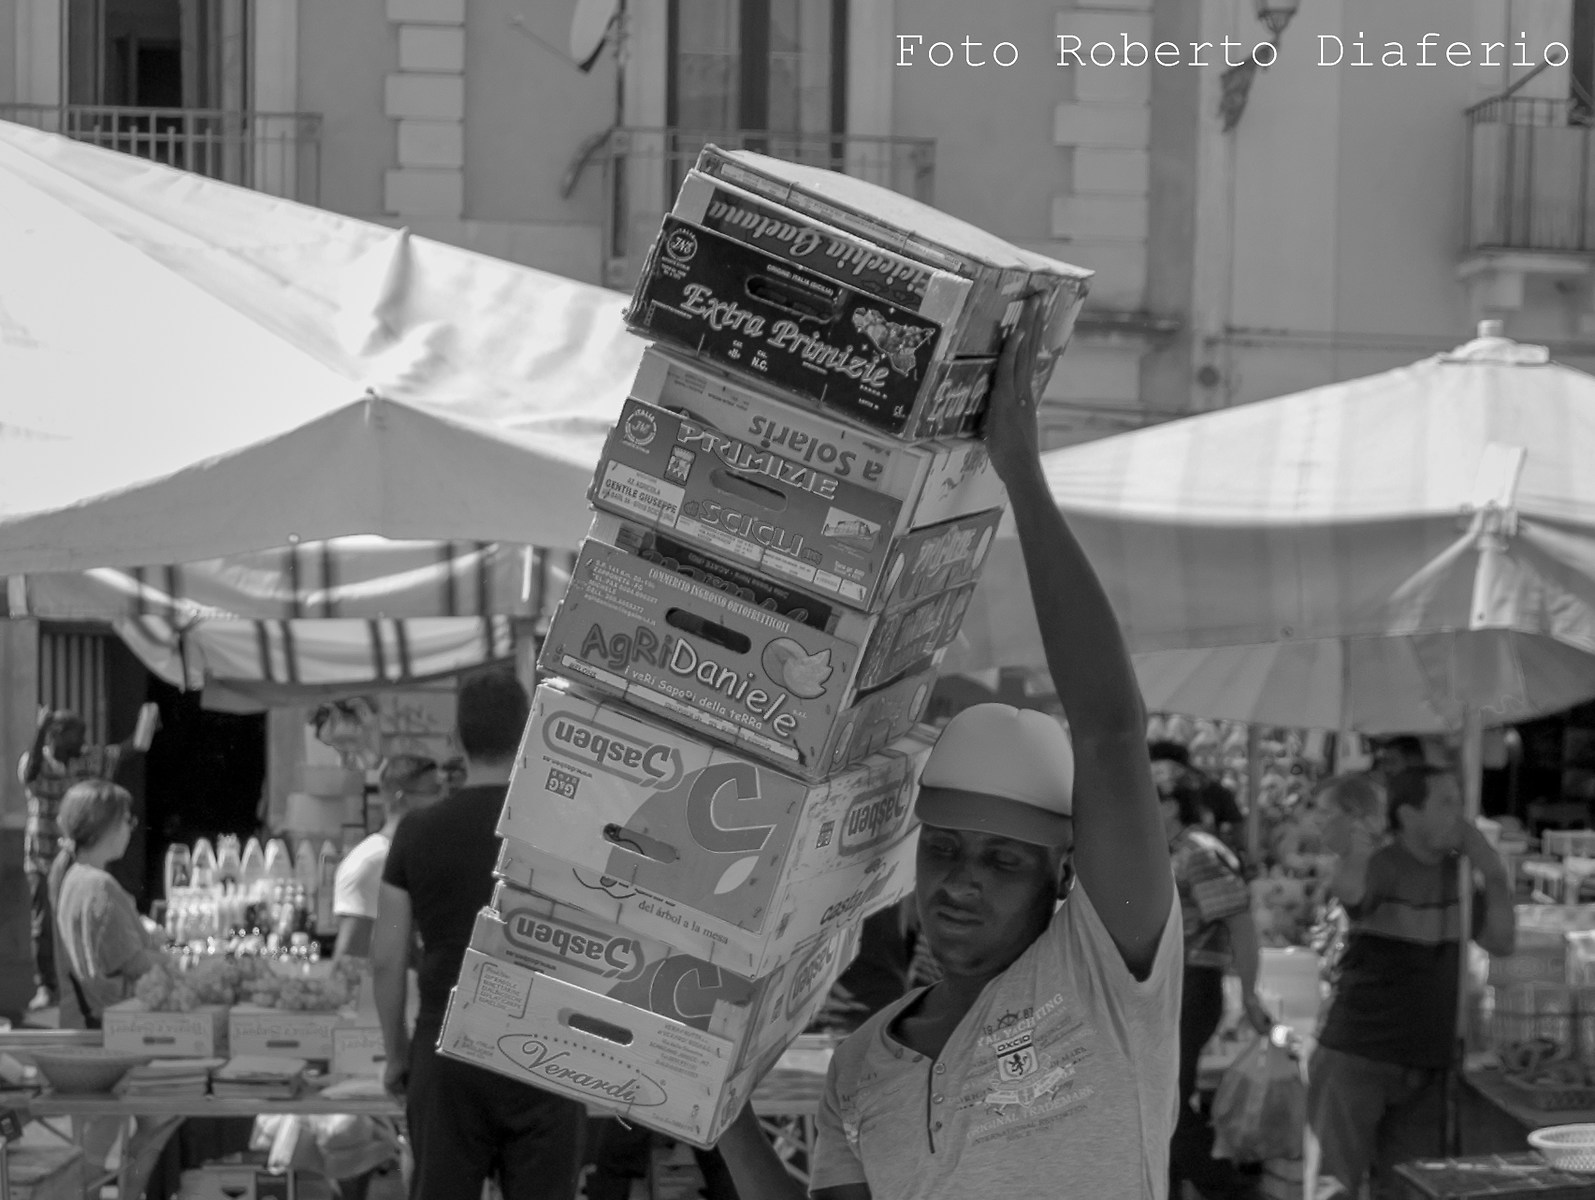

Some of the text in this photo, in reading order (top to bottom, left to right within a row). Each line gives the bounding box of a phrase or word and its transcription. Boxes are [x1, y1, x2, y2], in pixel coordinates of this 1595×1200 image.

[708, 201, 823, 256] Gaetana
[680, 283, 890, 387] Extra Primizie
[676, 421, 839, 500] PRIMIZIE
[748, 415, 857, 476] Solaris
[606, 478, 638, 499] GENTILE
[700, 500, 804, 557] SCICLI
[699, 696, 726, 716] della
[638, 900, 655, 913] del
[690, 921, 702, 933] la
[702, 927, 729, 945] mesa
[521, 1040, 640, 1103] Verardi
